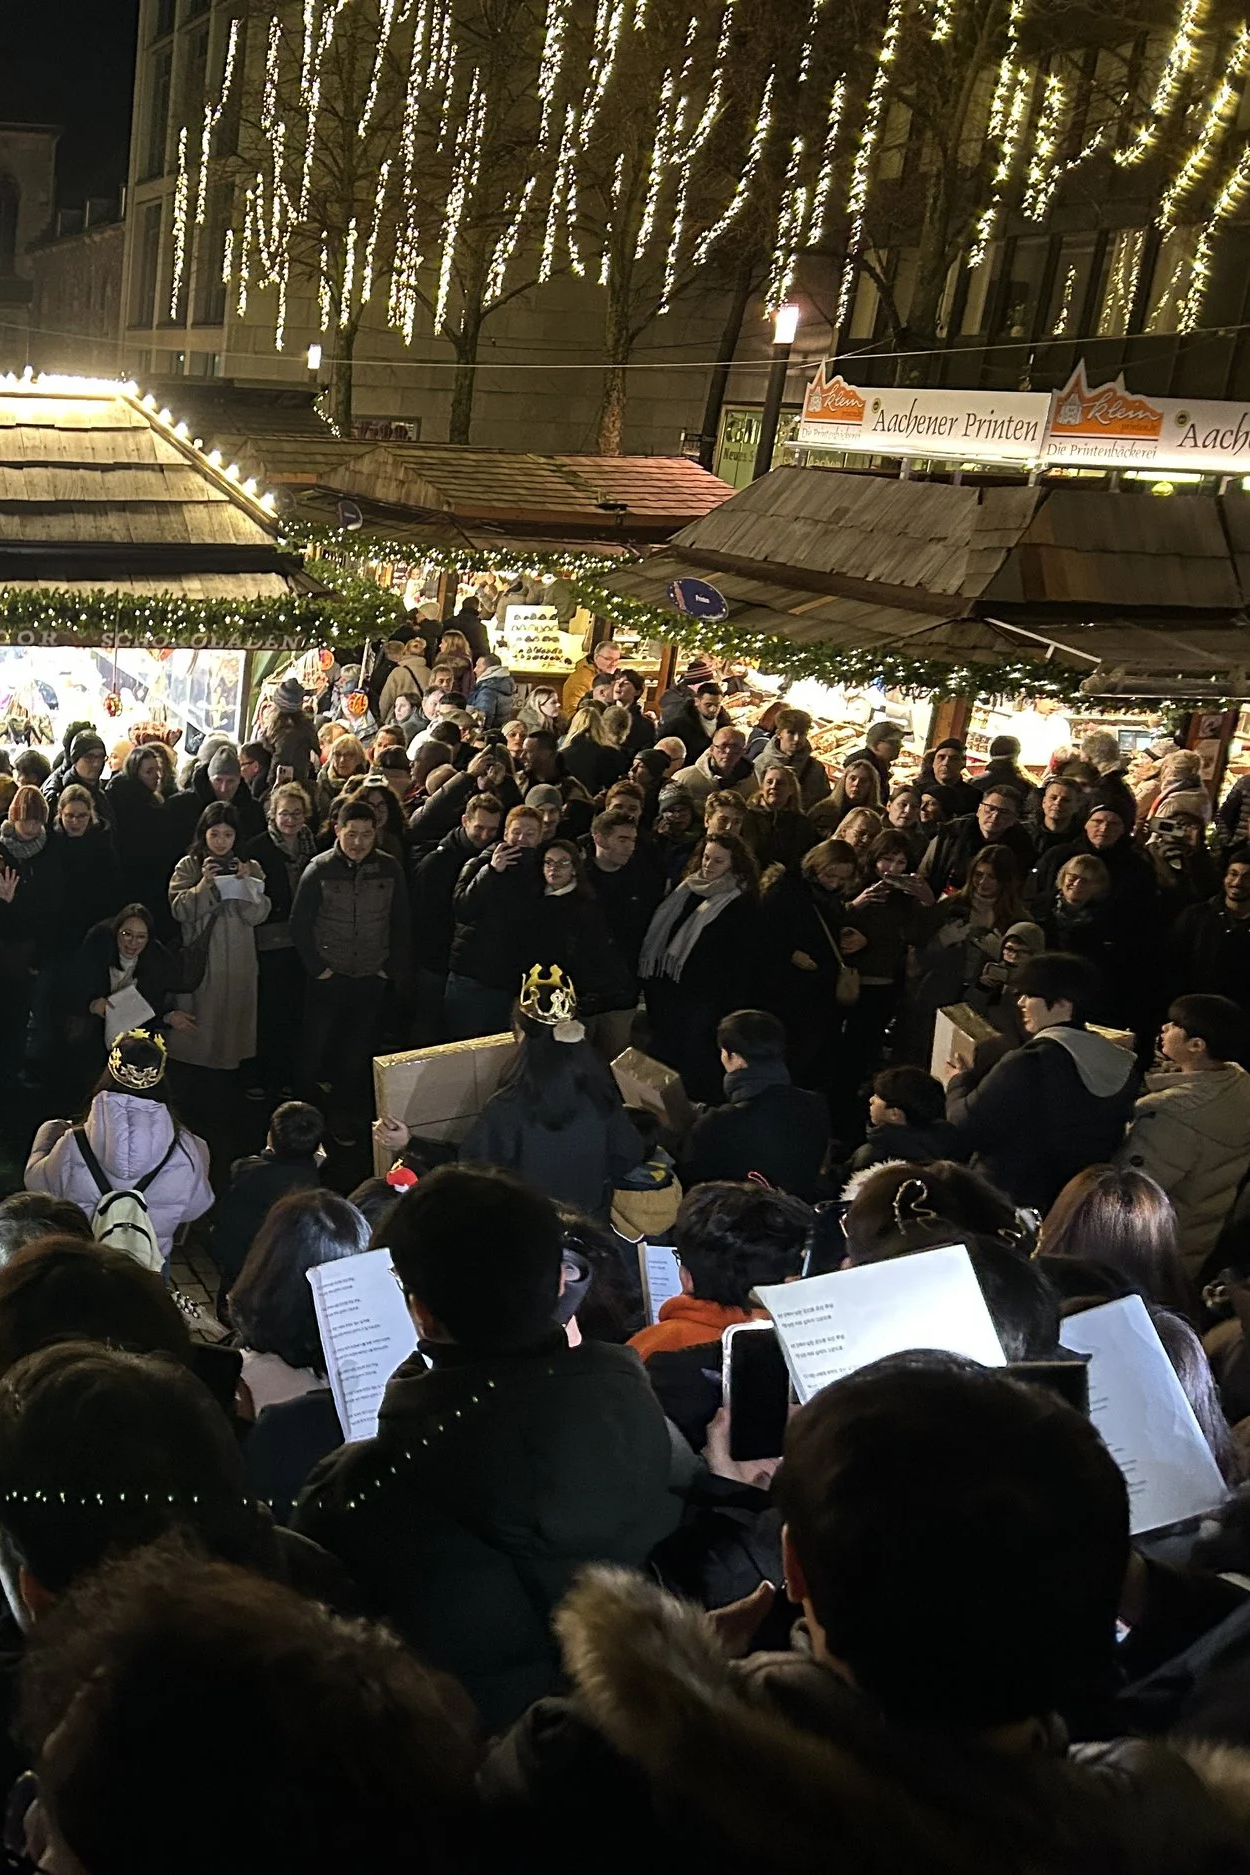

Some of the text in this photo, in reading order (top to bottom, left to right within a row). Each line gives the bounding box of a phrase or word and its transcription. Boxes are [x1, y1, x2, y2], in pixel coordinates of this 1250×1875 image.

[872, 398, 1040, 442] Aachener Printen
[1177, 412, 1250, 456] Aach
[1047, 440, 1158, 459] Die Printenbäckerei
